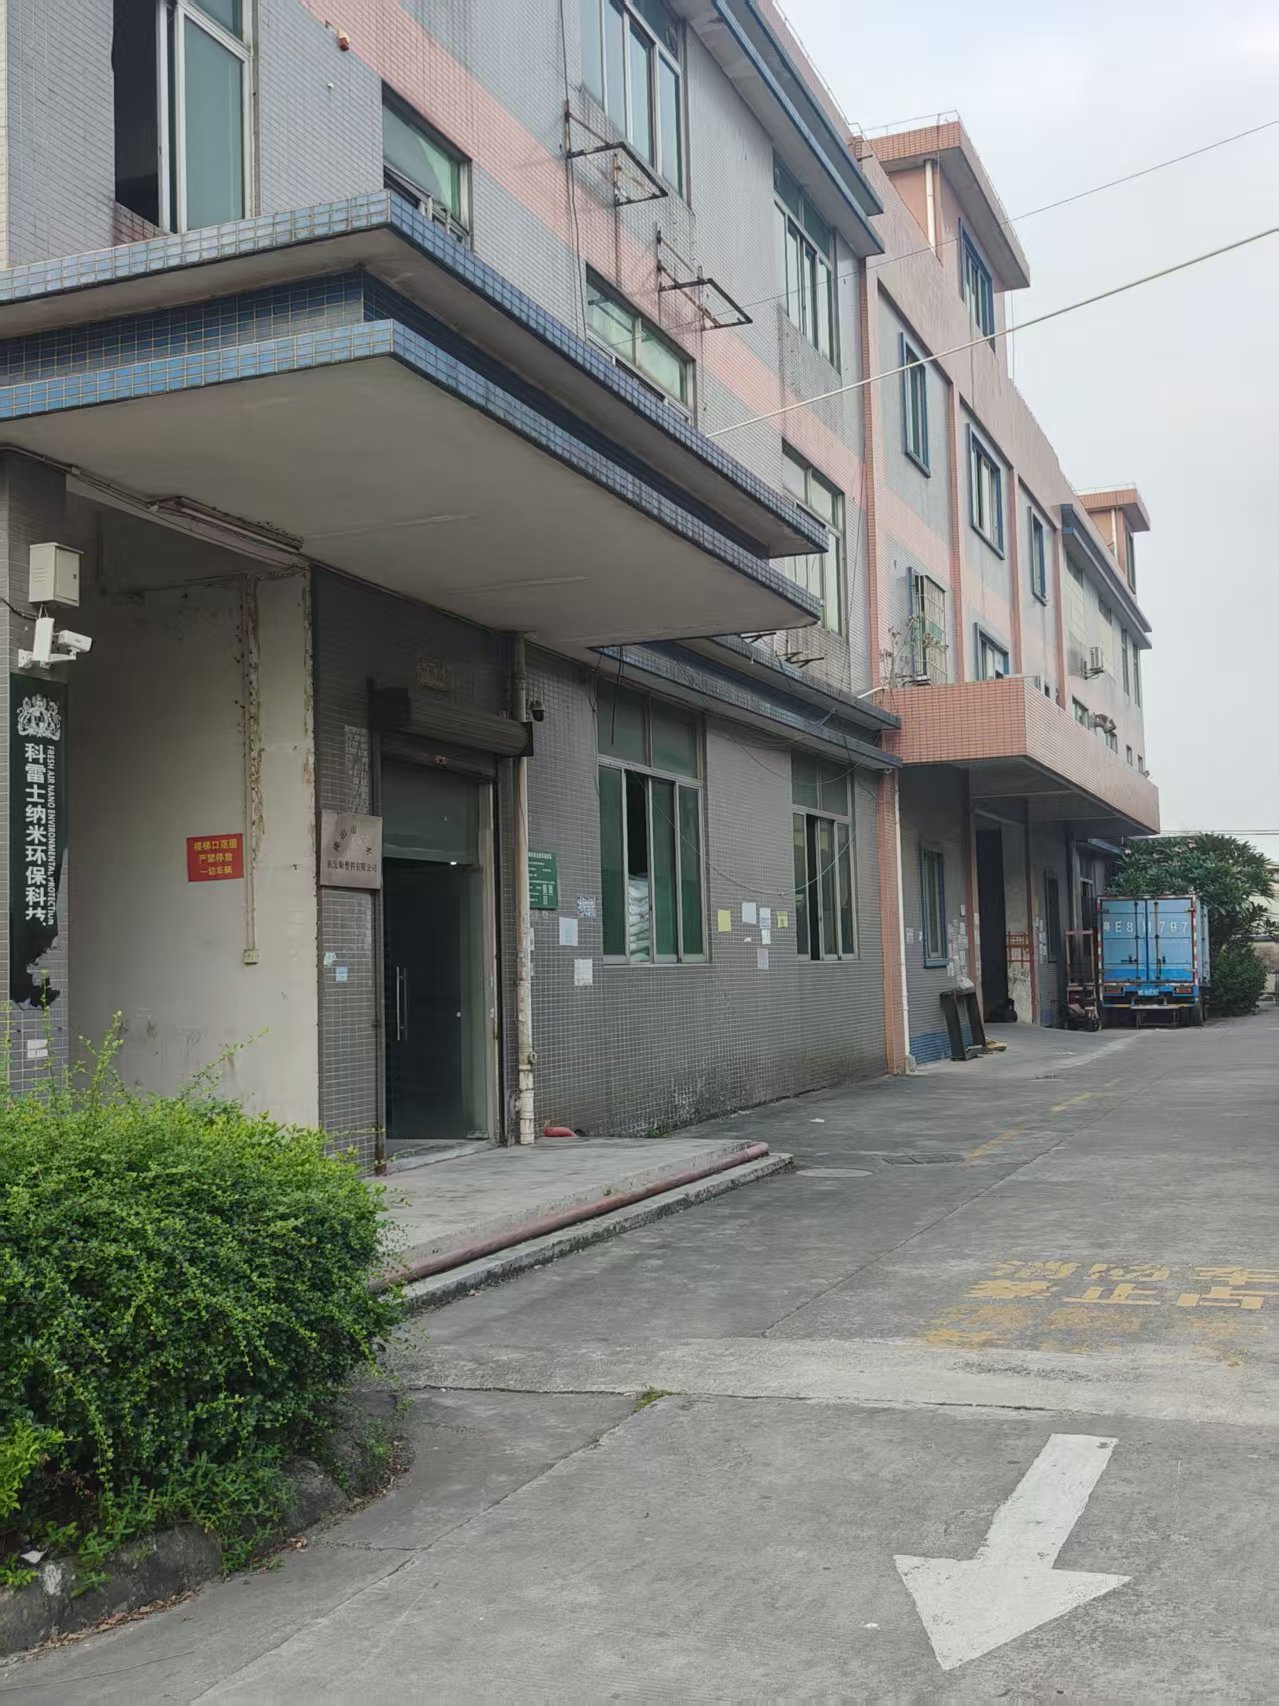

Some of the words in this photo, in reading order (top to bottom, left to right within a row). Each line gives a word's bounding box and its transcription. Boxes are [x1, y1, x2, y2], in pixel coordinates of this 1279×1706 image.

[47, 745, 55, 769] FRESH
[47, 770, 55, 784] AIR
[47, 785, 56, 808] NANO
[47, 809, 56, 875] ENVIRONMENTAL
